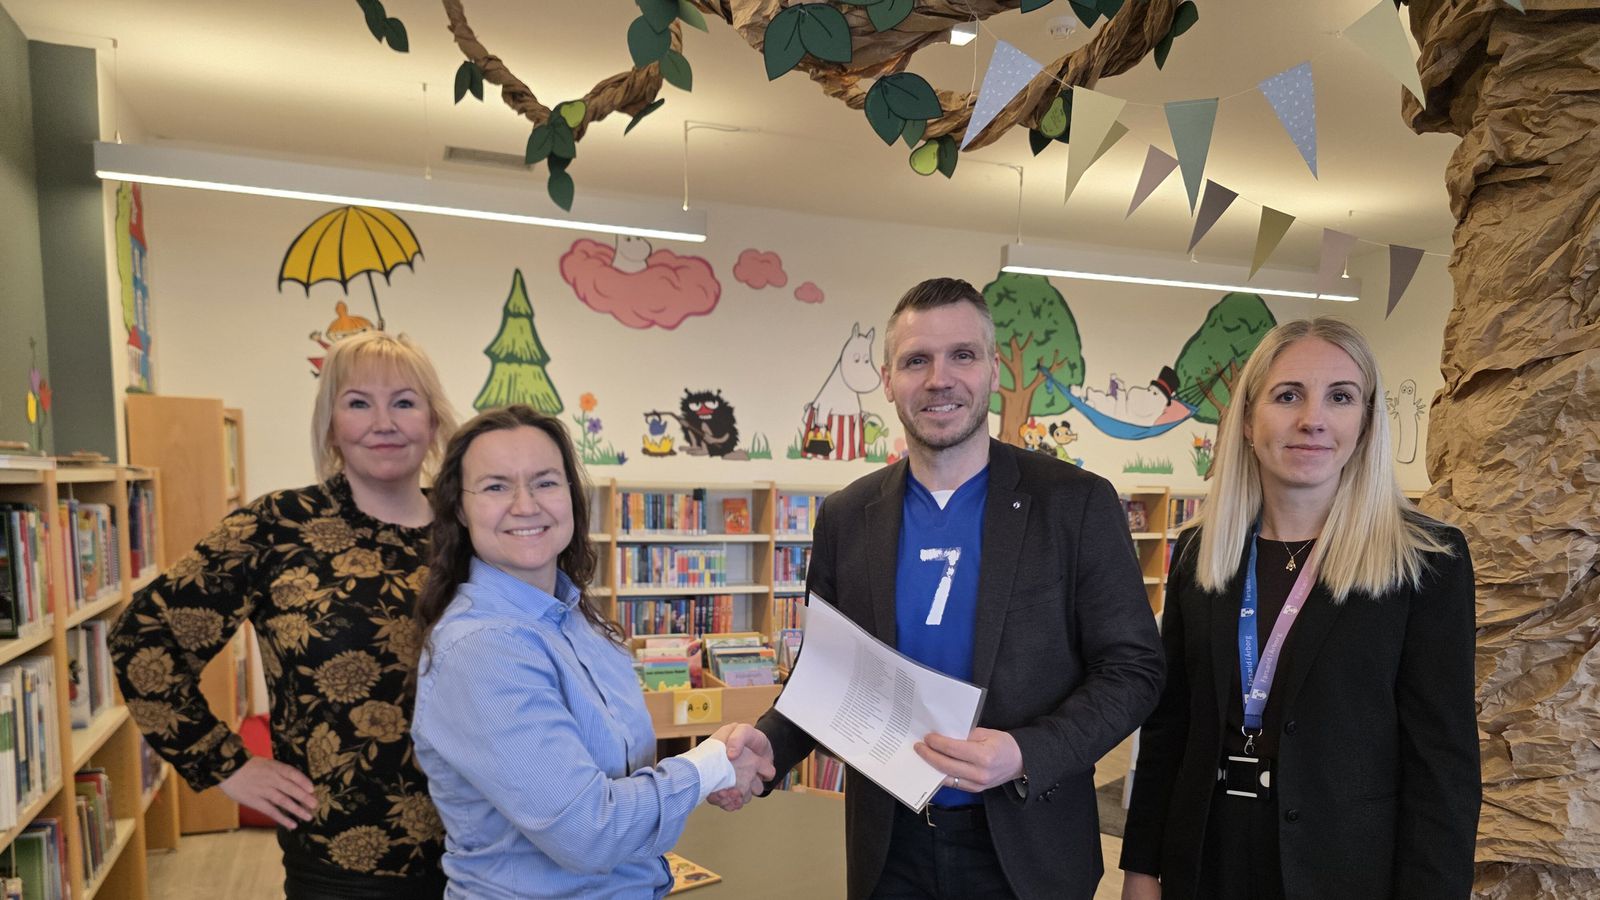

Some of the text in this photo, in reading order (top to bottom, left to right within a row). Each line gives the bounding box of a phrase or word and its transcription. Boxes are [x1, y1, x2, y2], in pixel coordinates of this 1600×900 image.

[919, 547, 961, 626] 7
[1246, 661, 1254, 687] Farsæld
[687, 703, 694, 712] A
